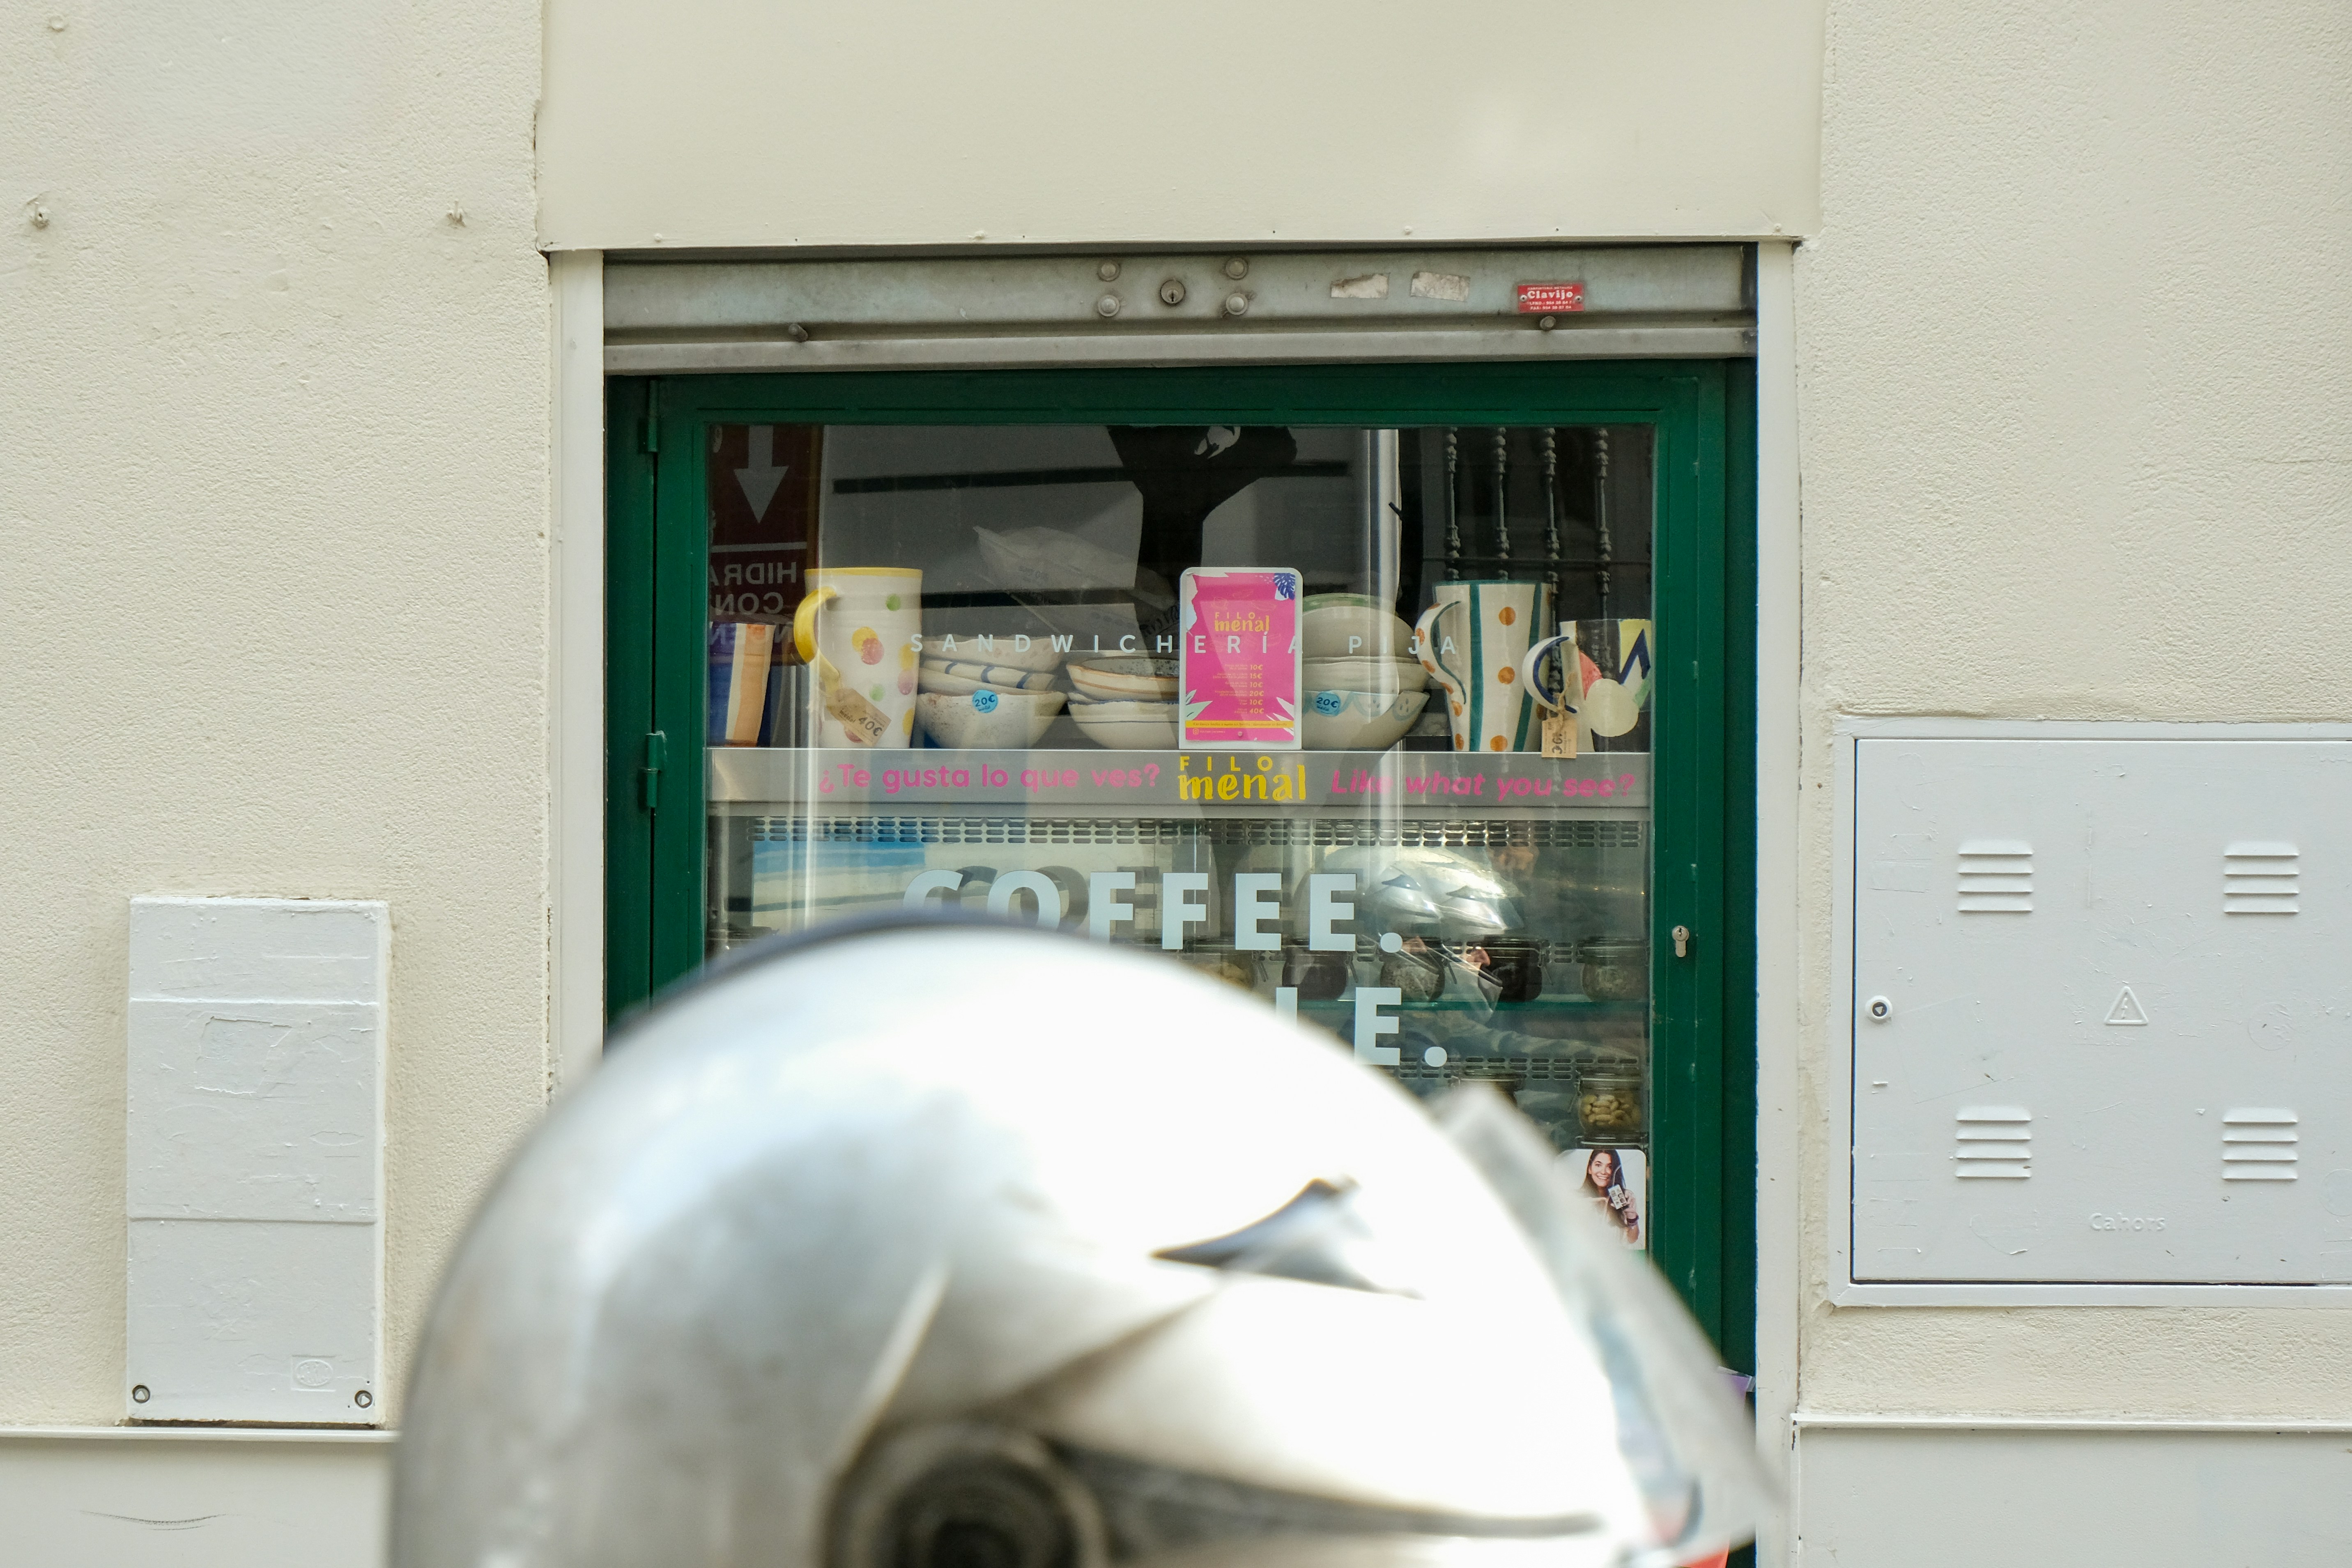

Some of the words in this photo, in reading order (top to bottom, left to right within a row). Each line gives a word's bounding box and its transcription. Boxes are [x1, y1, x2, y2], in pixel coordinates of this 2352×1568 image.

[1527, 290, 1573, 300] Clavijo
[910, 631, 1303, 653] SANDWICHERÍA
[1348, 635, 1456, 654] PIJA
[975, 694, 996, 707] 20€
[1316, 697, 1338, 708] 20€
[858, 717, 883, 736] 40€
[819, 763, 871, 793] ¿Te
[882, 765, 970, 794] gusta
[982, 763, 1009, 787] lo
[1020, 769, 1079, 793] que
[1091, 763, 1160, 787] ves?
[1331, 770, 1393, 793] Like
[1405, 771, 1486, 795] what
[1496, 777, 1552, 802] you
[1563, 773, 1635, 797] see?
